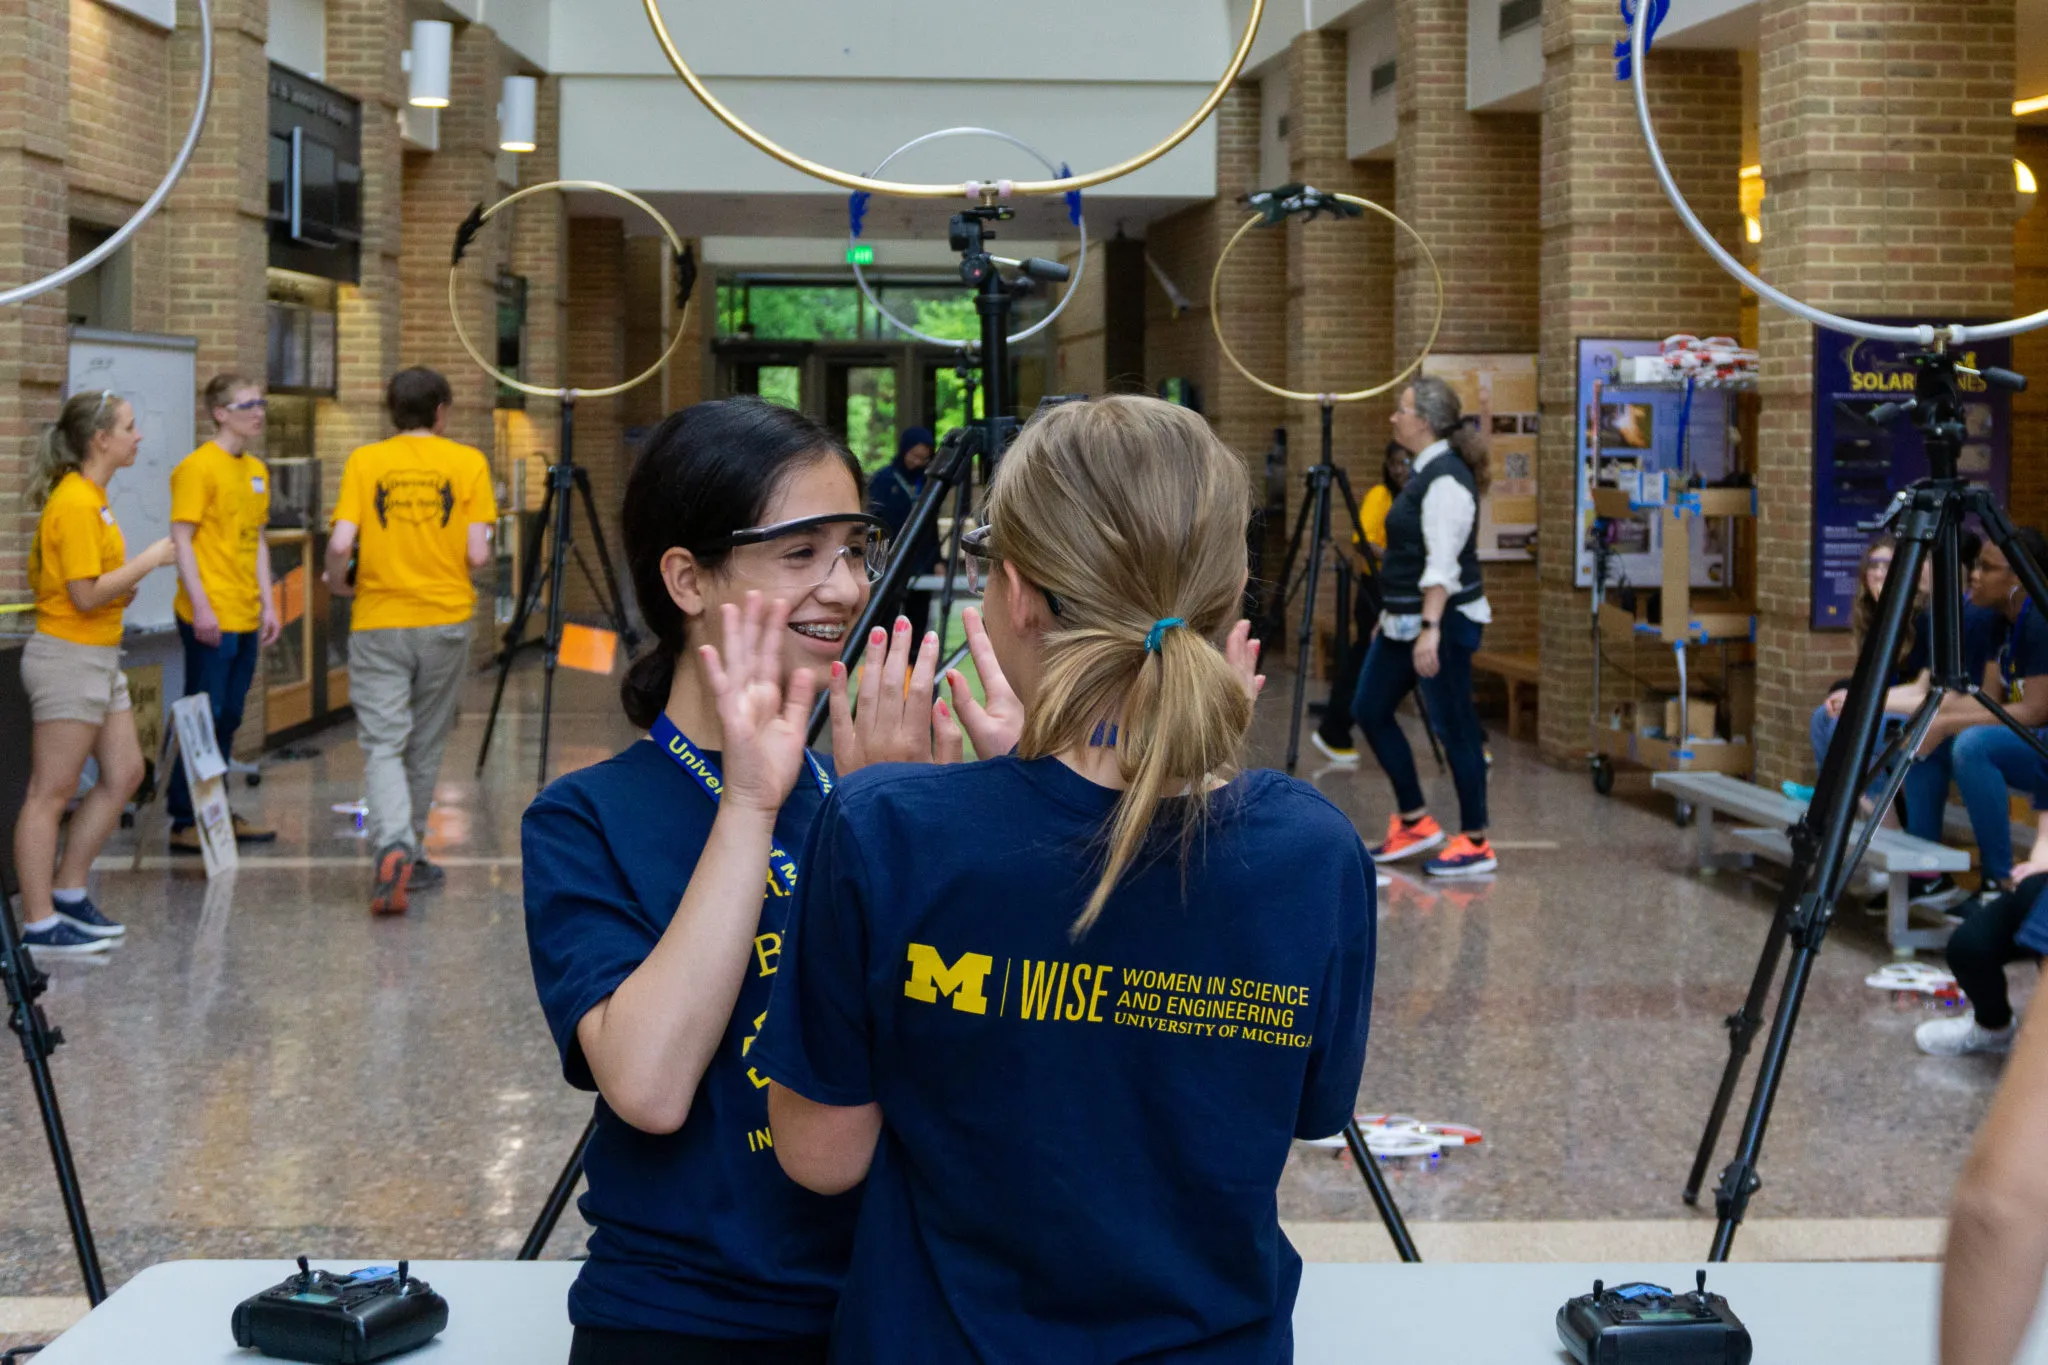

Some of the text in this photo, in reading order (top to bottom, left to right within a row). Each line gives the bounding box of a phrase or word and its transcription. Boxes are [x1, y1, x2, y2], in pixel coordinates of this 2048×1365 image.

[1851, 371, 1915, 391] SOLAR
[904, 942, 1113, 1022] M WISE
[1122, 968, 1310, 1006] WOMEN IN SCIENCE
[1114, 1011, 1216, 1037] UNIVERSITY
[1218, 1024, 1239, 1038] OF
[1116, 990, 1294, 1028] AND ENGINEERING
